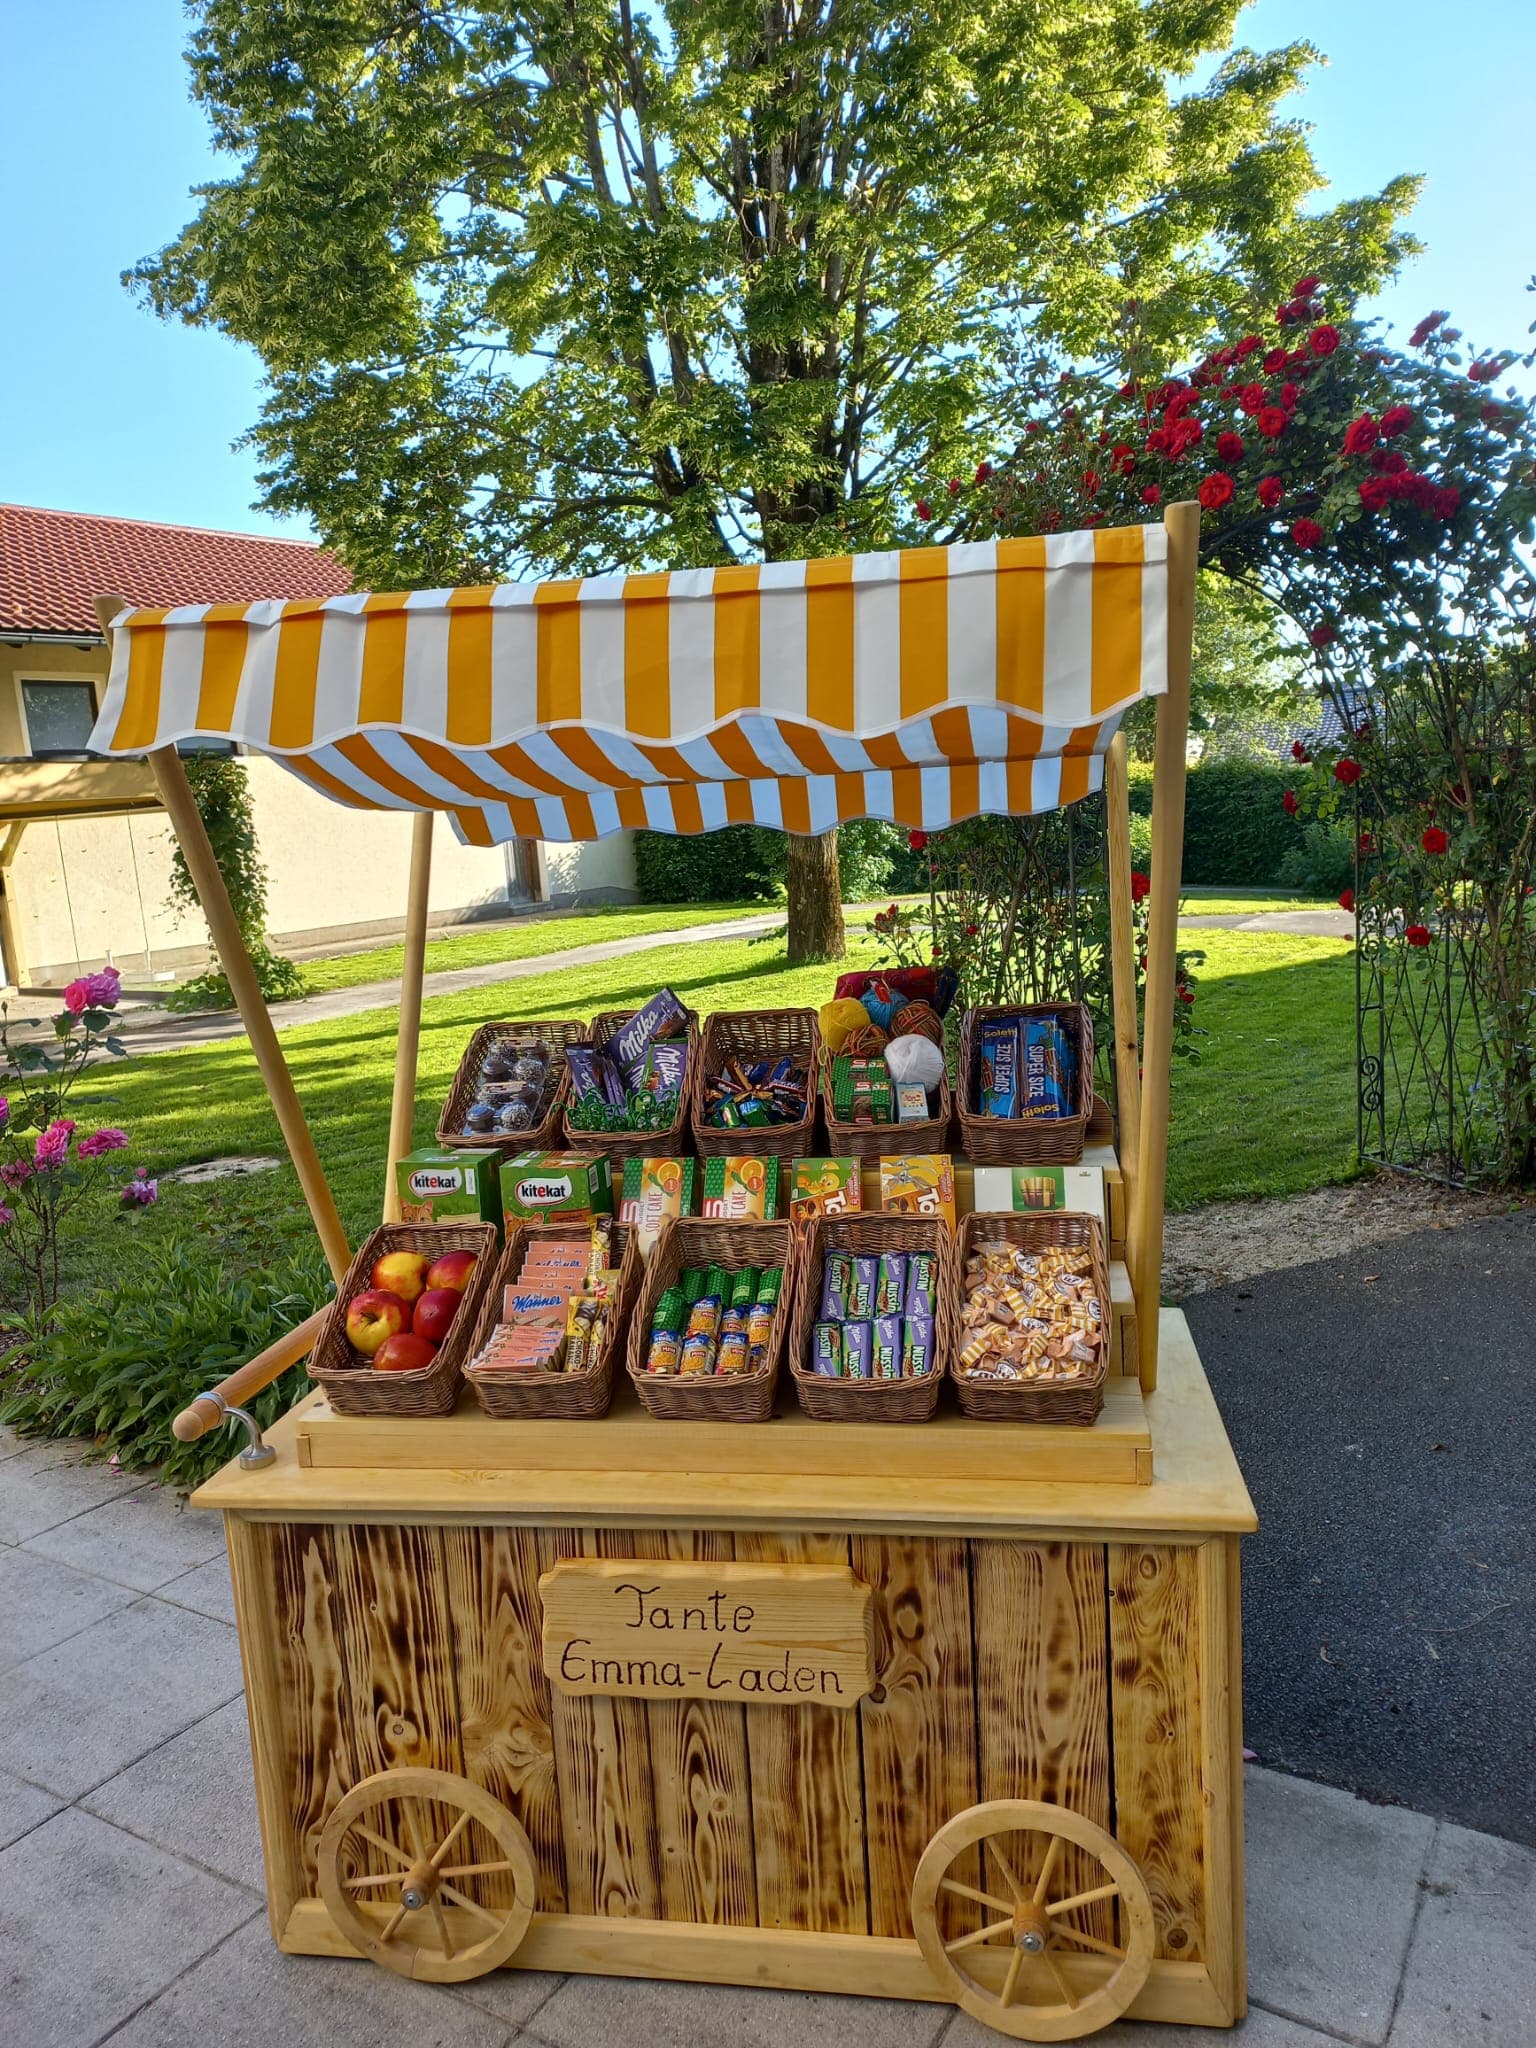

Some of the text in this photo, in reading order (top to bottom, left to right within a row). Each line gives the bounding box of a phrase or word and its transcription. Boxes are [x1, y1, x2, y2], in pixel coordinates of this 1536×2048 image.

[619, 1010, 658, 1061] Milka
[655, 1047, 682, 1086] Milka
[994, 1043, 1012, 1094] SUPER SIZE
[1028, 1045, 1044, 1098] SUPER SIZE
[414, 1175, 456, 1189] kitekat
[521, 1184, 566, 1198] kitekat
[647, 1192, 663, 1211] CAKE
[731, 1191, 746, 1210] CAKE
[511, 1294, 562, 1313] Manner
[614, 1583, 754, 1633] Tante
[560, 1638, 843, 1694] Emma-Laden
